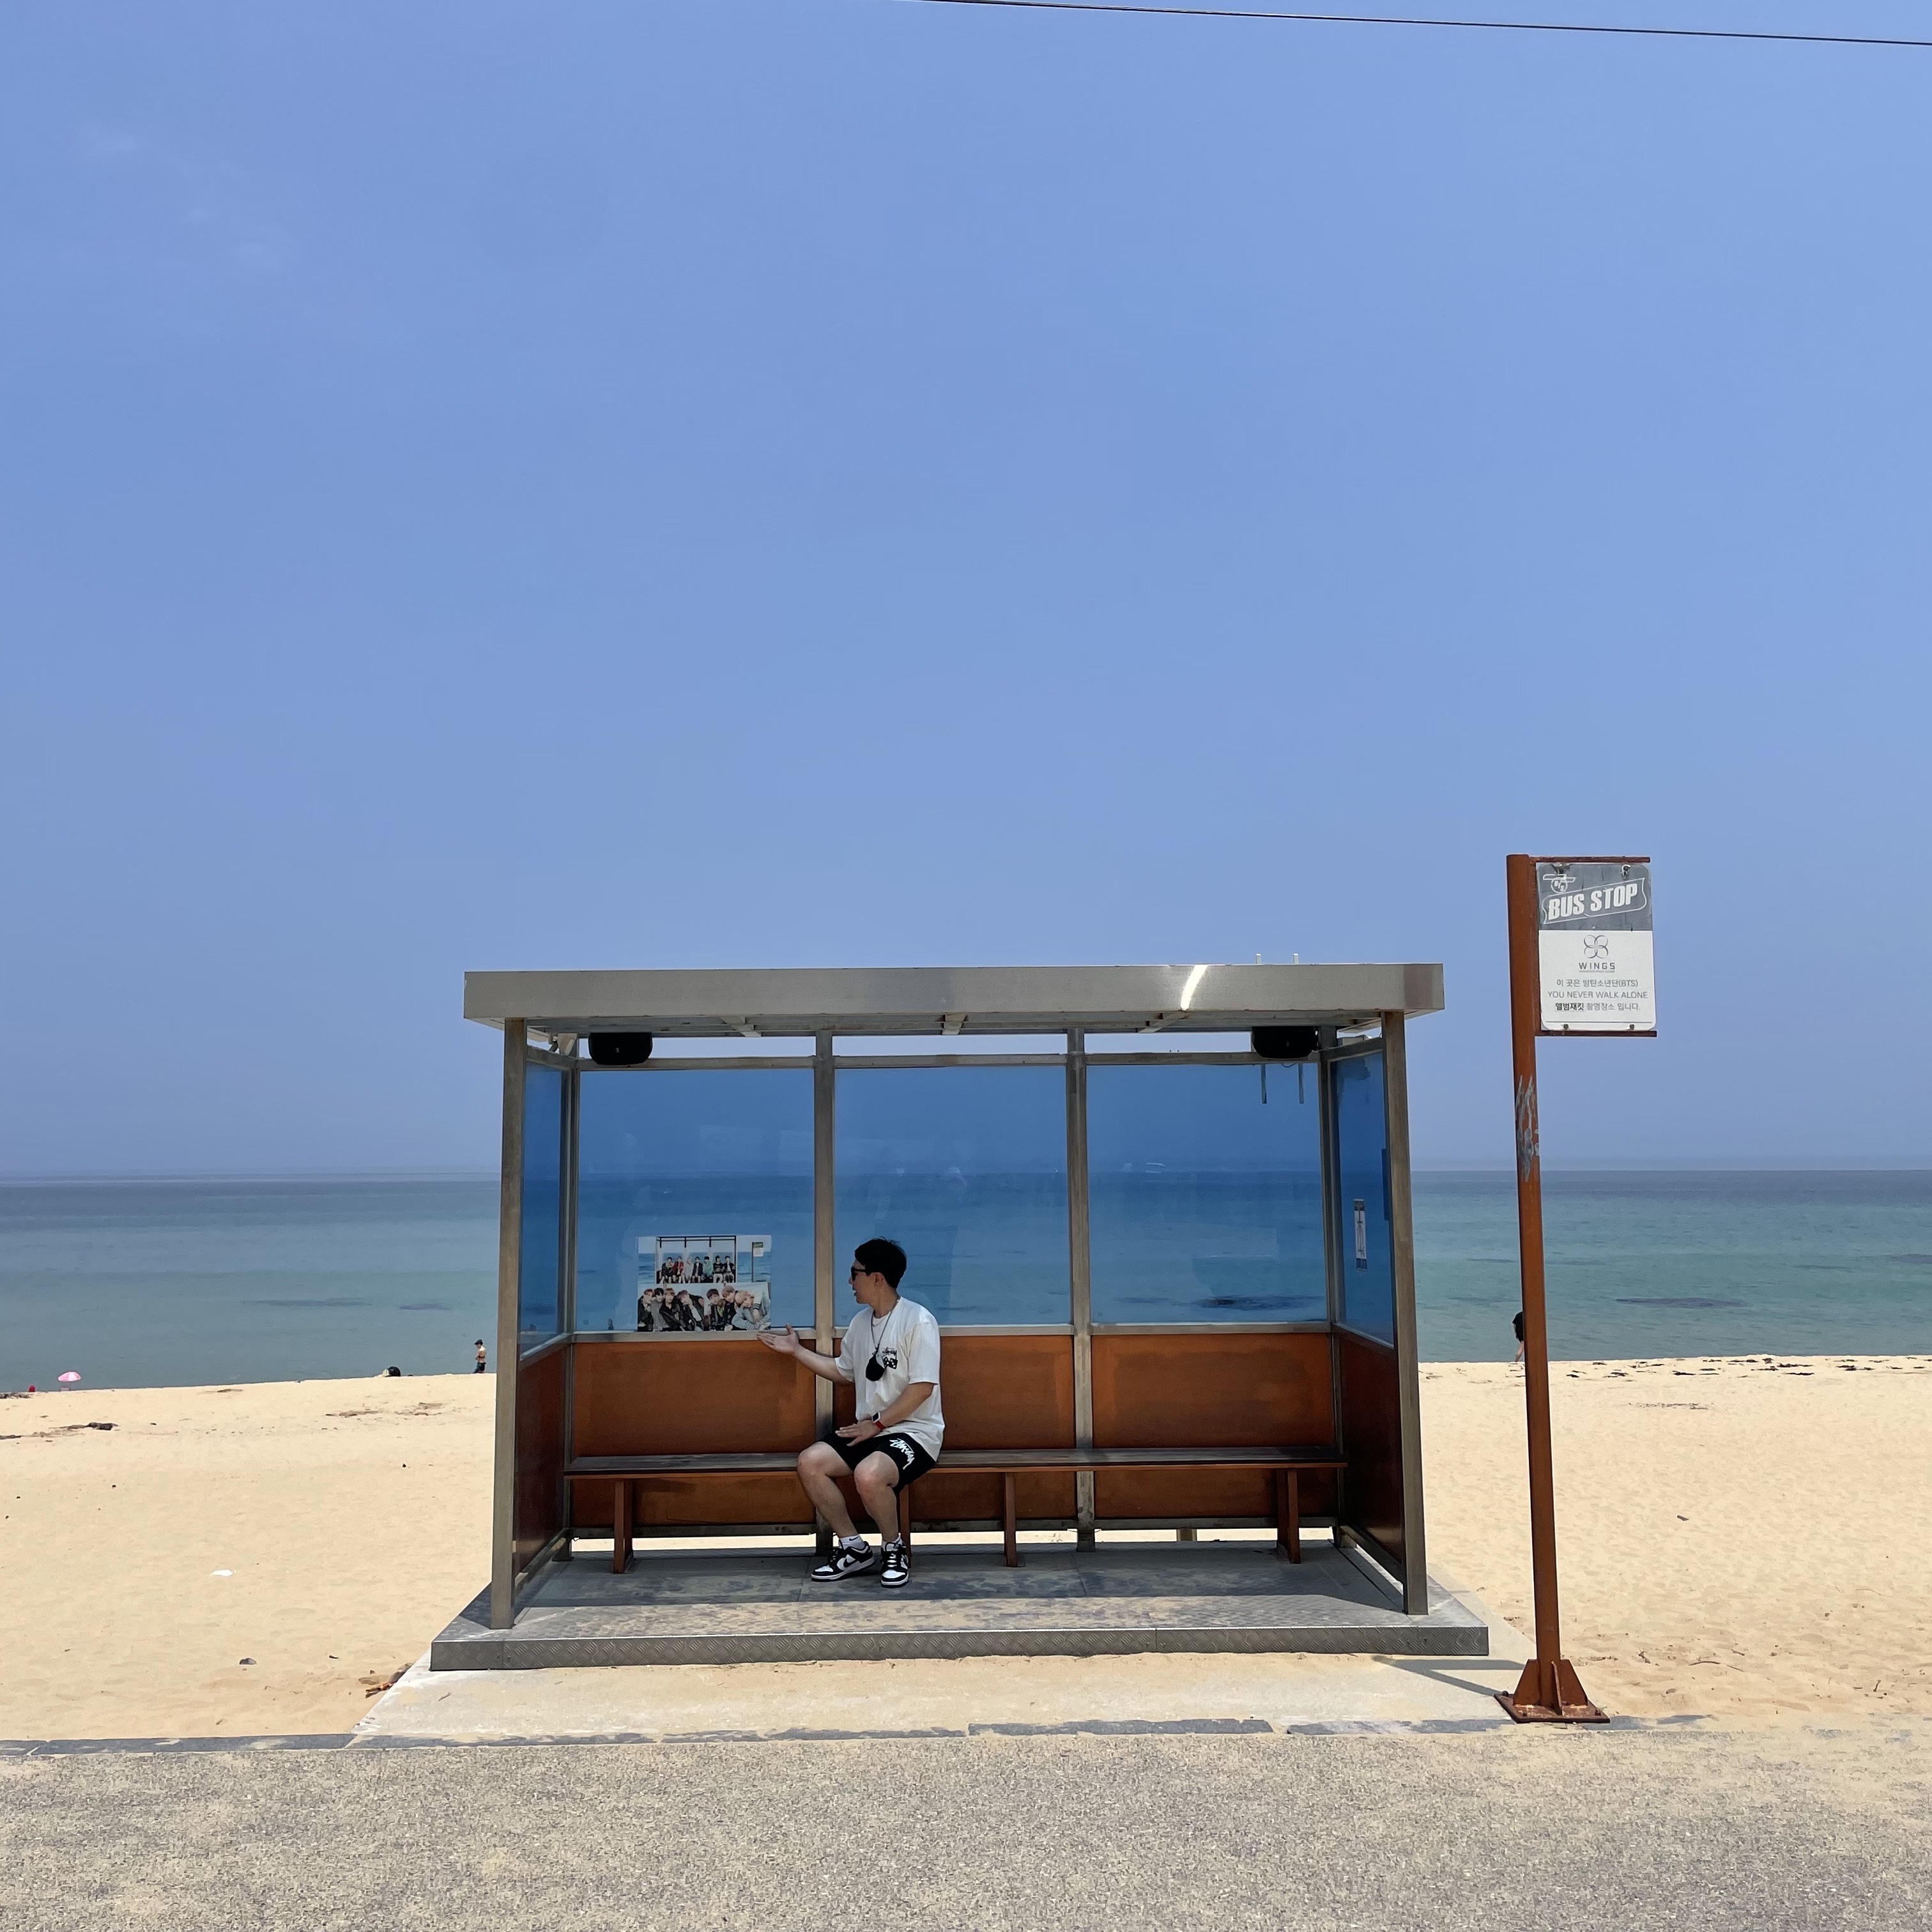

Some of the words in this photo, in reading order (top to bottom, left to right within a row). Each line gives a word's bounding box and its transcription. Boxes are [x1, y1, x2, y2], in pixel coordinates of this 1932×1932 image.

[1554, 880, 1565, 892] BTS
[1548, 893, 1585, 921] BUS
[1590, 884, 1638, 912] STOP
[1556, 979, 1564, 987] 이
[1566, 979, 1580, 987] 곳은
